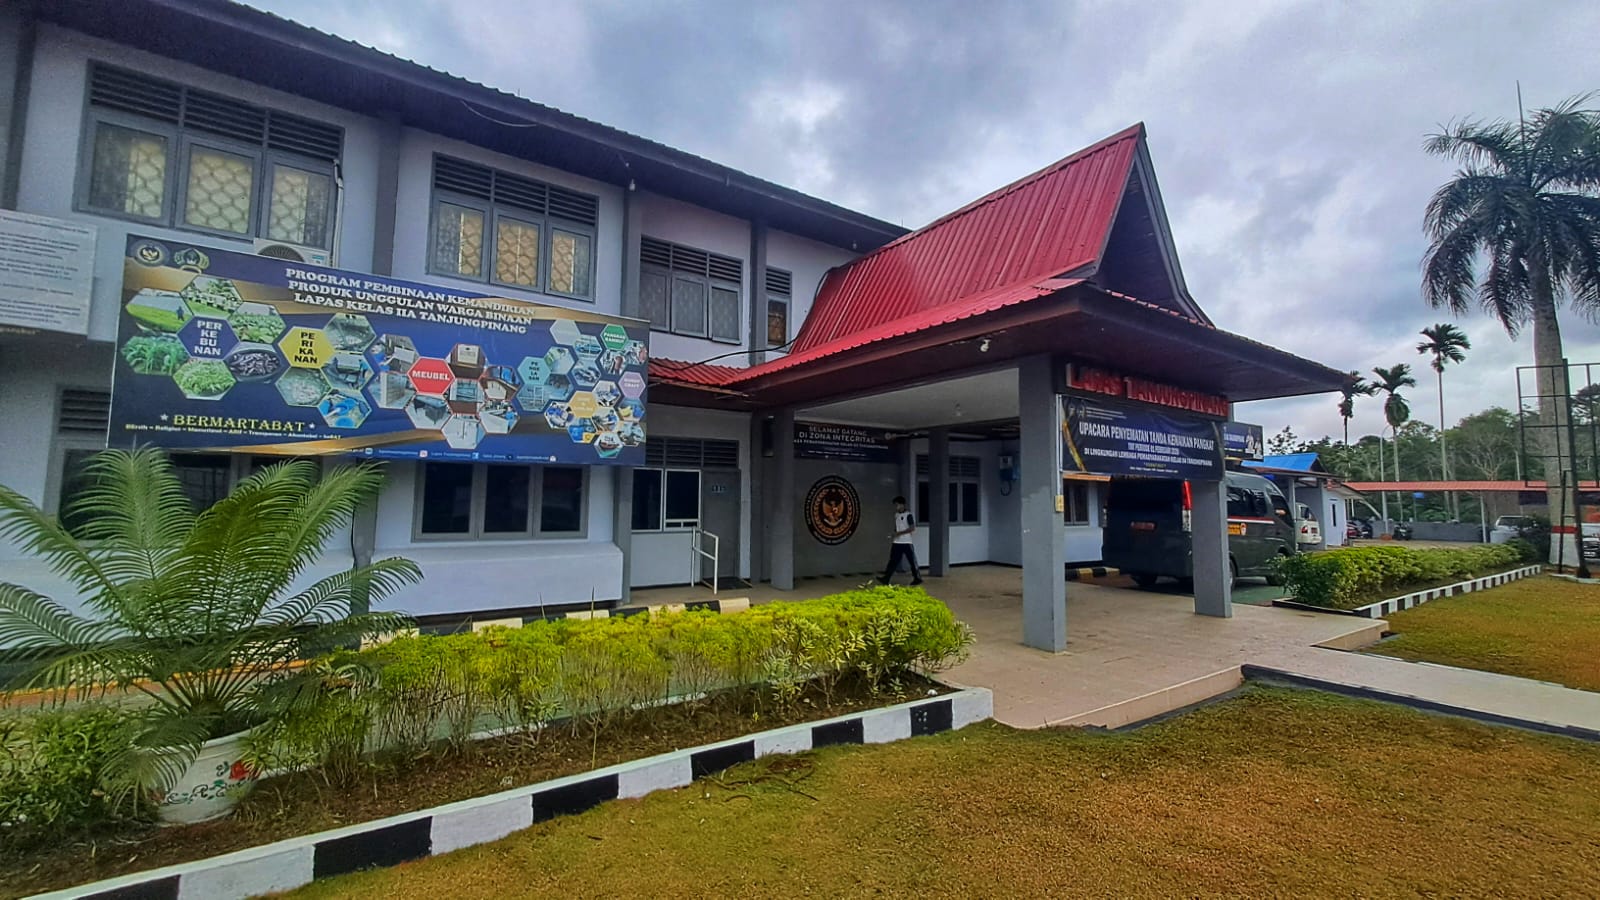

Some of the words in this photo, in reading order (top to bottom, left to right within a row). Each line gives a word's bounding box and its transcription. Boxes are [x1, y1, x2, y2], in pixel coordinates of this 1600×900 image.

[286, 268, 361, 288] PROGRAM
[364, 280, 445, 301] PEMBINAAN
[447, 294, 535, 315] KEMANDIRIAN
[288, 280, 352, 298] PRODUK
[355, 291, 434, 311] UNGGULAN
[437, 303, 483, 318] WARGA
[485, 311, 532, 325] BINAAN
[294, 293, 344, 308] LAPAS
[346, 300, 394, 315] KELAS
[396, 308, 417, 319] IIA
[419, 311, 527, 334] TANJUNGPINANG
[197, 320, 223, 330] PER
[201, 329, 218, 338] KE
[300, 332, 315, 340] PE
[200, 338, 217, 346] BU
[194, 346, 221, 355] NAN
[299, 347, 314, 355] KA
[294, 355, 317, 364] NAN
[412, 370, 450, 380] MEUBEL
[173, 415, 305, 432] BERMARTABAT
[1079, 421, 1110, 438] UPACARA
[1111, 427, 1149, 443] PENYEMATAN
[809, 432, 831, 440] ZONA
[832, 434, 875, 443] INTEGRITAS
